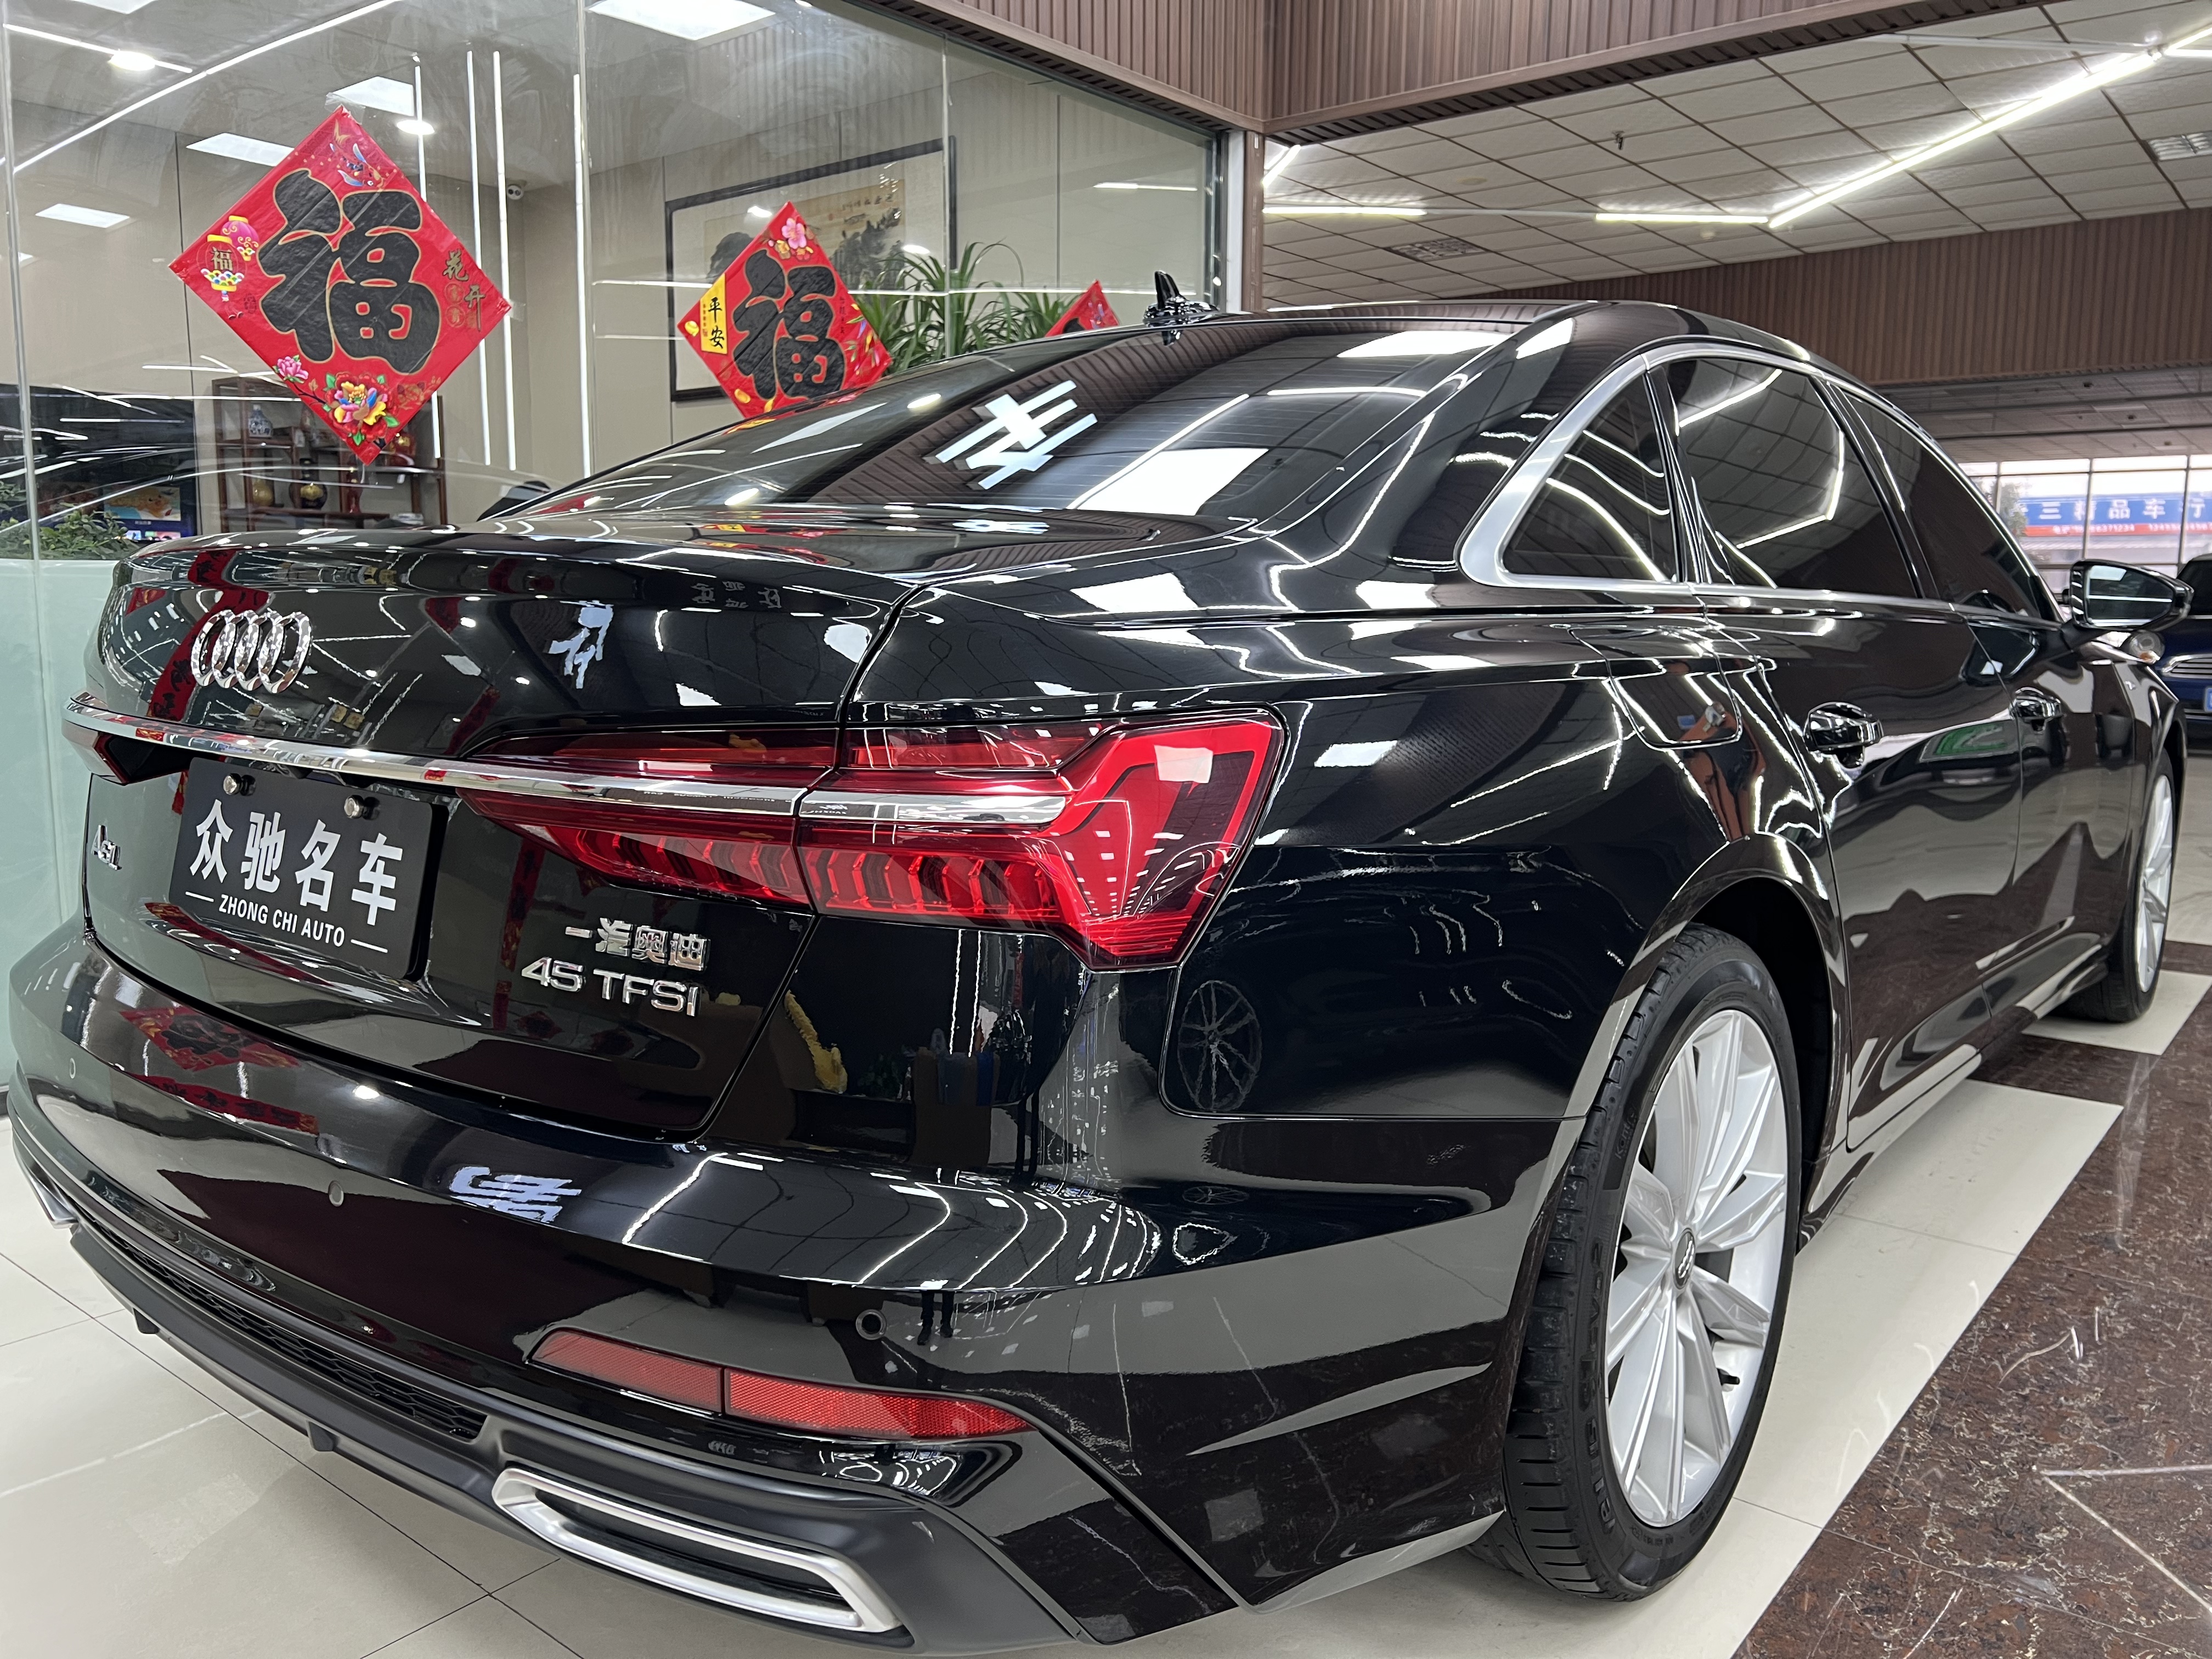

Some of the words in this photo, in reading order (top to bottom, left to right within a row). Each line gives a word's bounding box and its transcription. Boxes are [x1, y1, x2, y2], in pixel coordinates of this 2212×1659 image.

[256, 168, 441, 375] 福
[708, 297, 725, 349] 平安
[732, 249, 846, 400] 福
[189, 799, 404, 926] 众驰名车
[219, 894, 269, 924] ZHONG
[273, 909, 298, 933] CHI
[301, 918, 346, 947] AUTO
[565, 917, 709, 971] 一汽奥迪
[521, 956, 585, 993] 45
[592, 968, 703, 1017] TFSI
